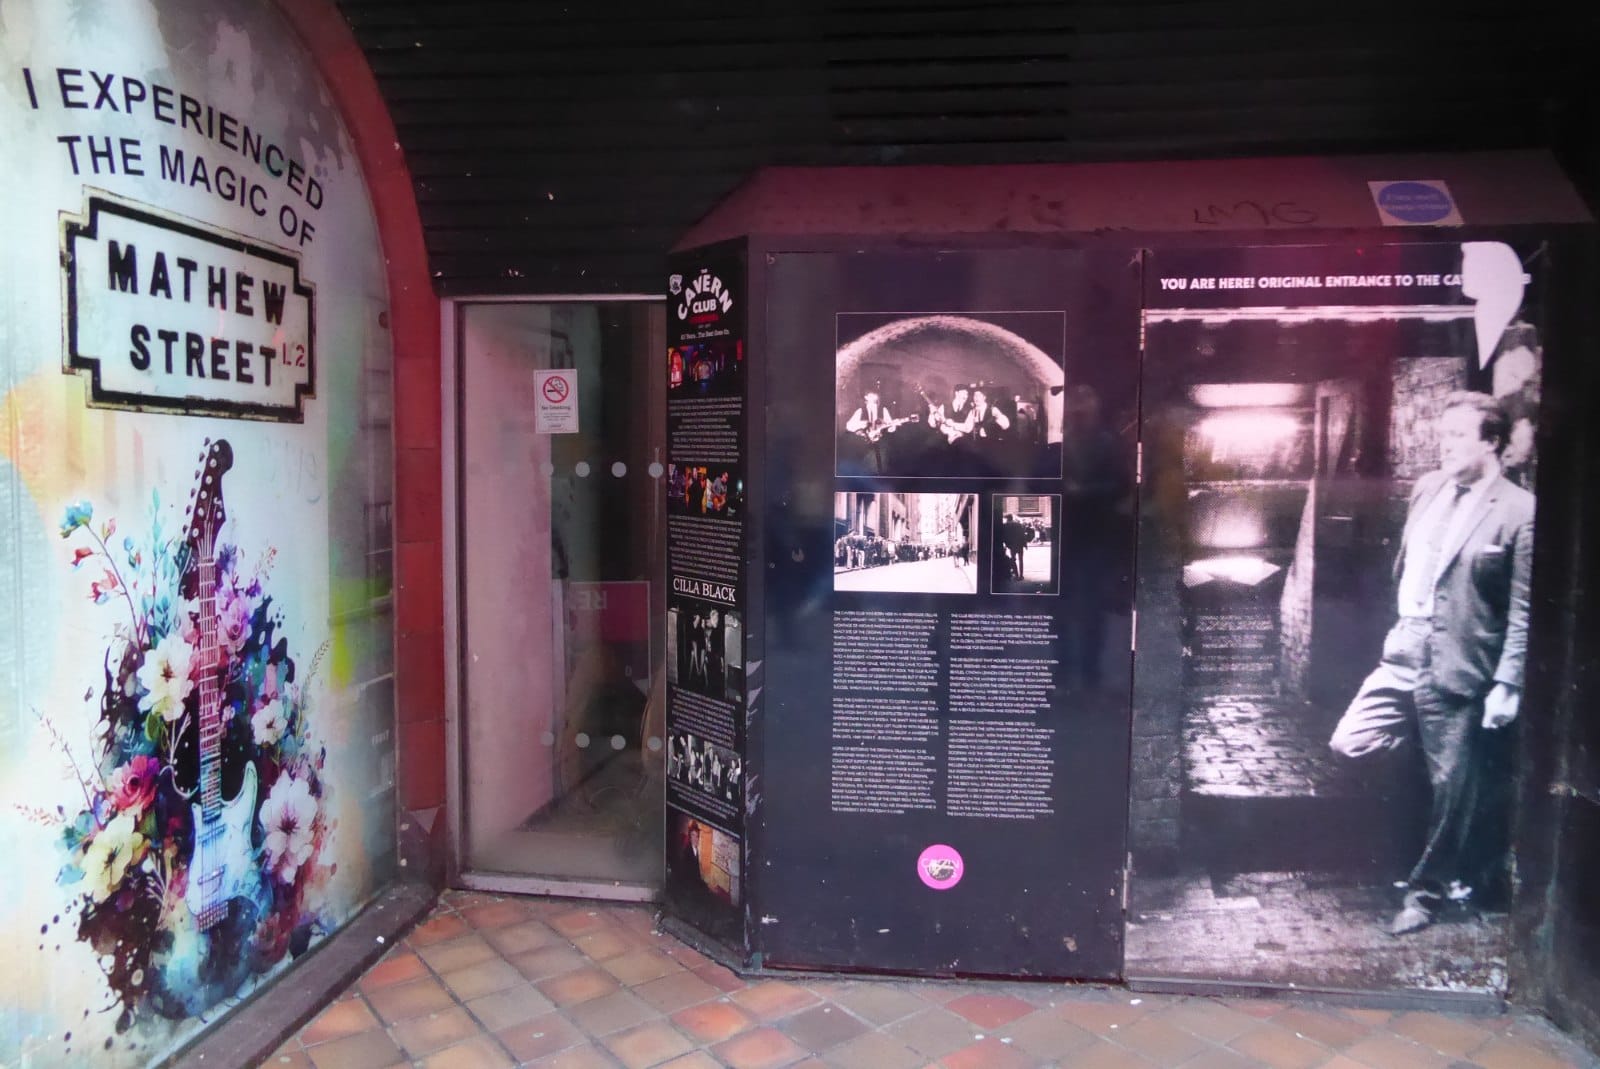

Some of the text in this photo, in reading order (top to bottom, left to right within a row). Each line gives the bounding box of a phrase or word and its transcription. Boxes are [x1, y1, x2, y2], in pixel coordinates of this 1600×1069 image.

[22, 67, 324, 210] I EXPERIENCED
[57, 135, 315, 246] THE MAGIC OF
[107, 240, 287, 326] MATHEW
[678, 274, 733, 320] CAVERN
[693, 298, 717, 314] CLUB
[1160, 278, 1187, 290] YOU
[1189, 278, 1216, 290] ARE
[1218, 276, 1255, 289] HERE!
[1258, 276, 1322, 289] ORIGINAL
[1325, 275, 1391, 288] ENTRANCE
[1394, 275, 1413, 287] TO
[1416, 274, 1440, 286] THE
[129, 324, 278, 386] STREET
[673, 577, 736, 602] CILLA BLACK
